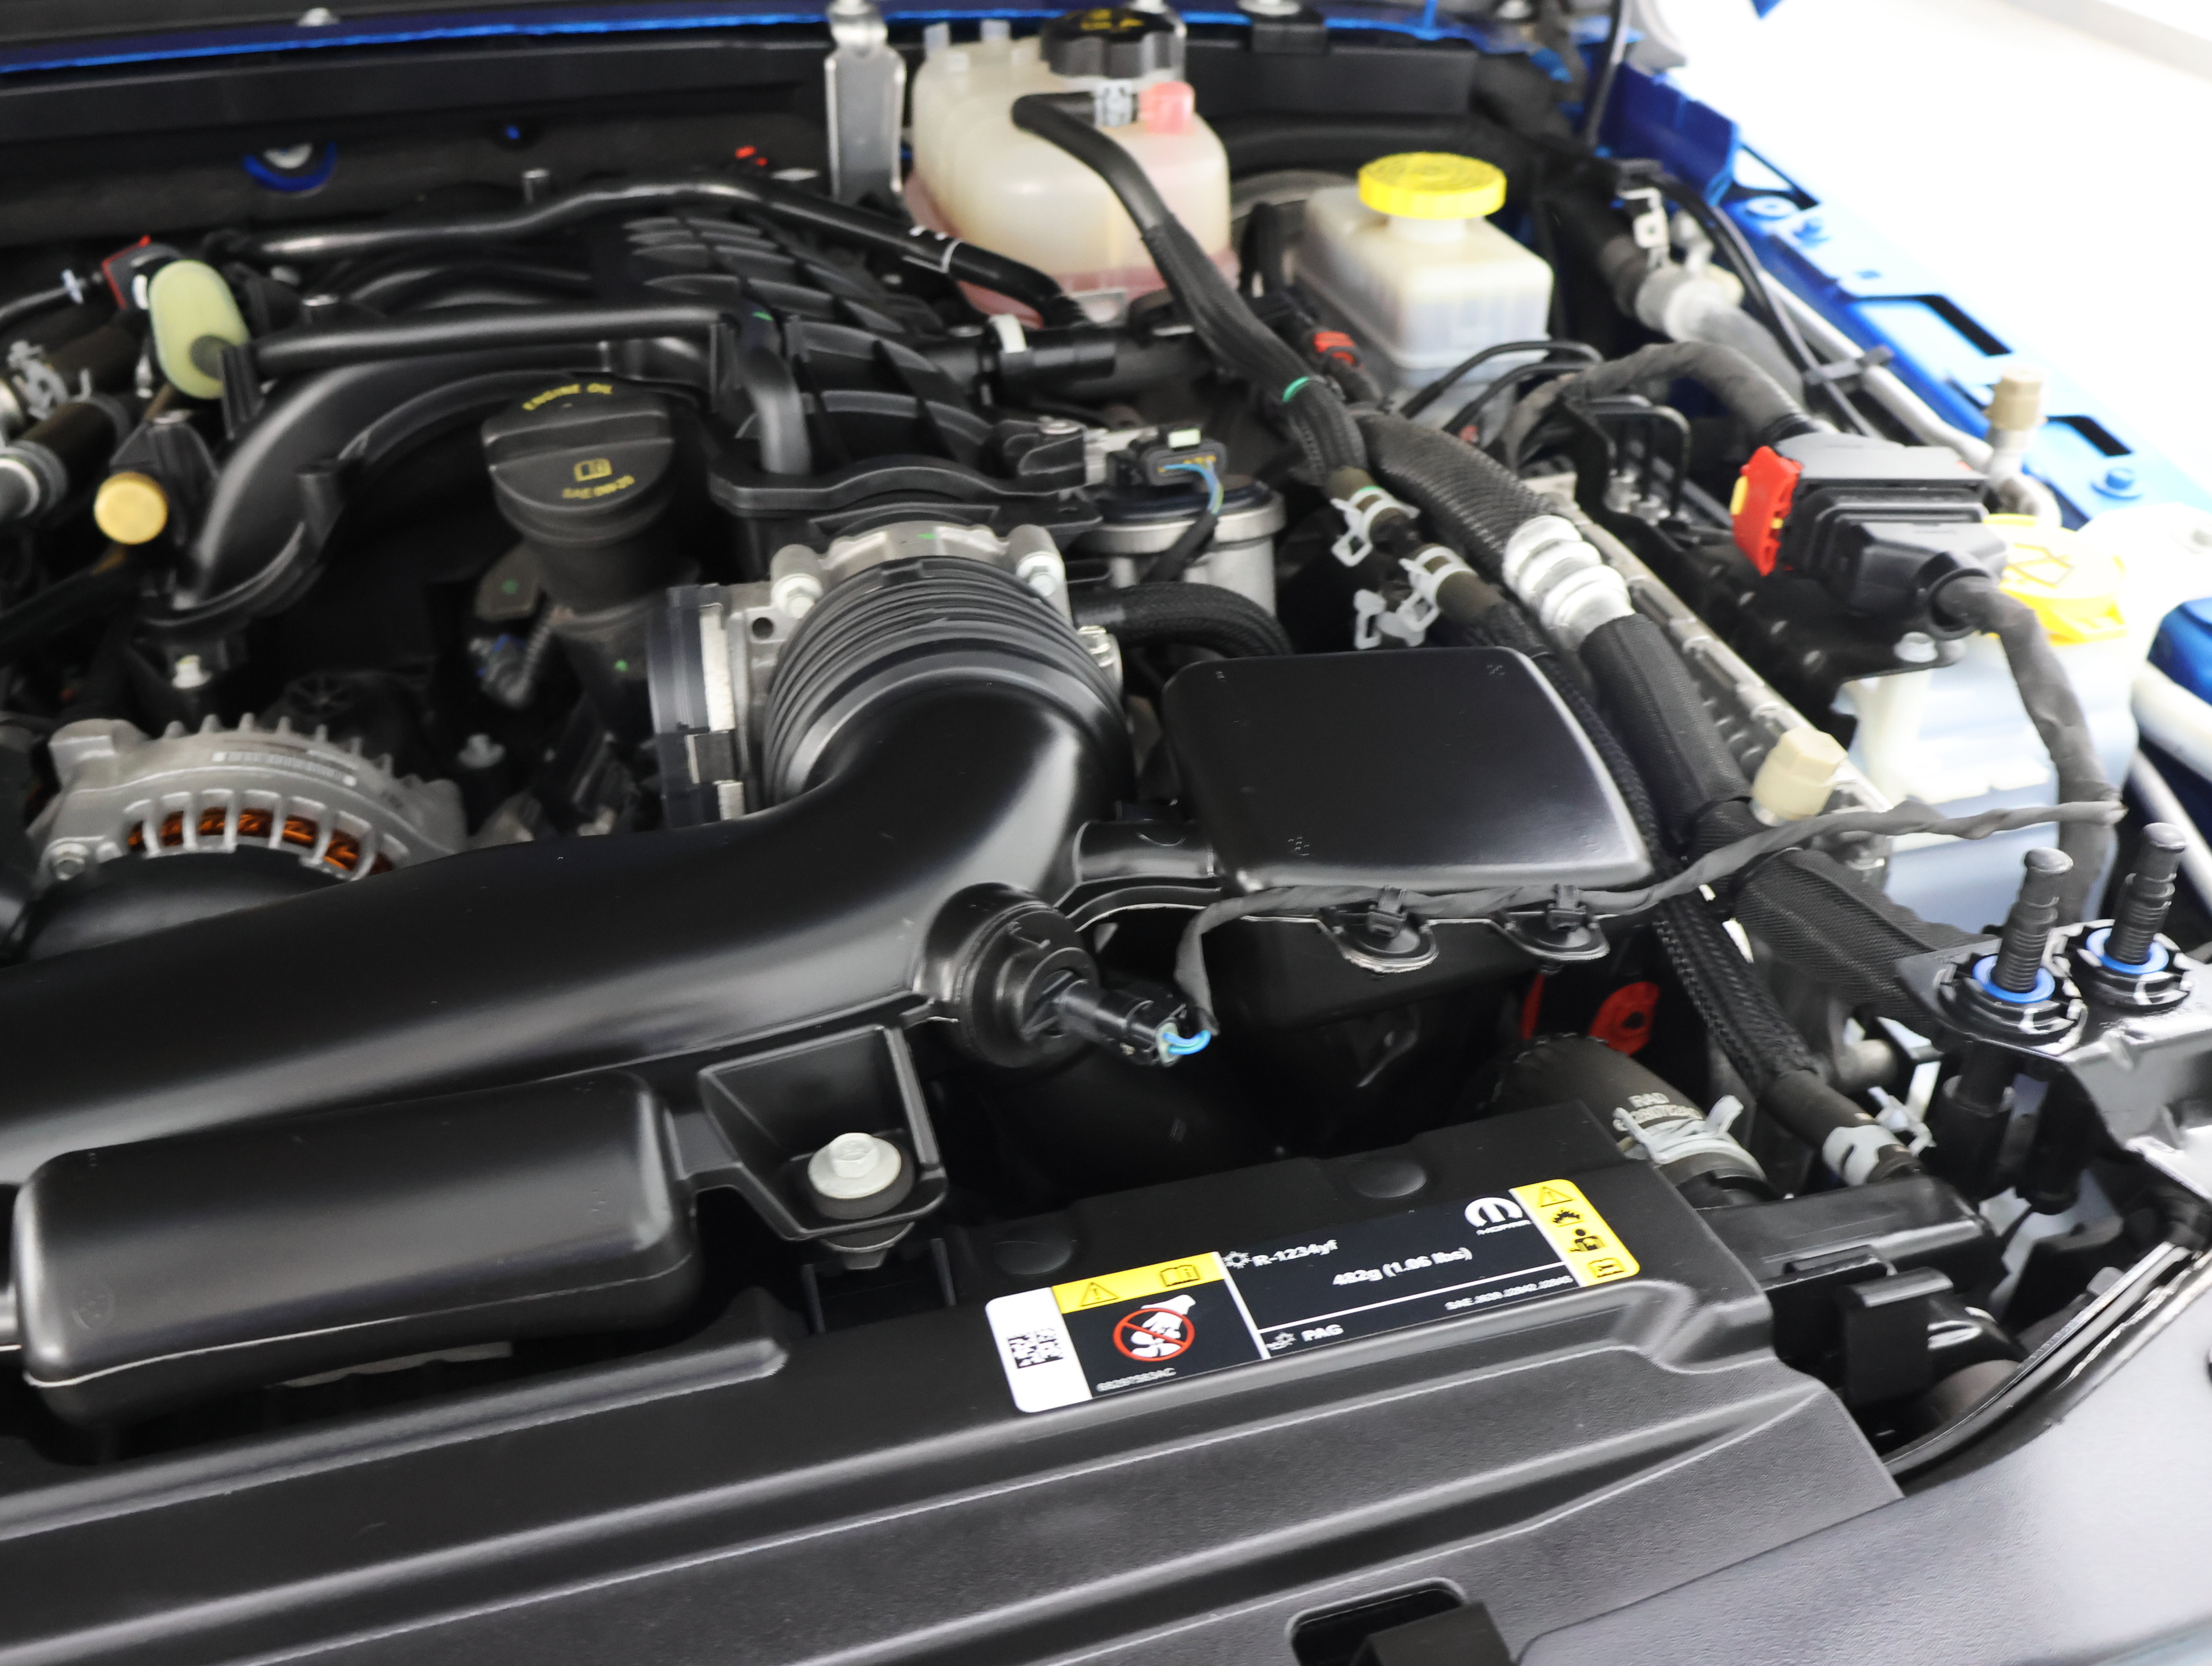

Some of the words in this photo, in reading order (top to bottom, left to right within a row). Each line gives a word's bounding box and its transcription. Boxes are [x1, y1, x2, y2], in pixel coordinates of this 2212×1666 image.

[1252, 1239, 1338, 1266] R-1234yf
[1333, 1269, 1383, 1285] 482g
[1382, 1256, 1432, 1277] (1.06
[1431, 1247, 1473, 1265] lbs)
[1444, 1298, 1474, 1310] SAE
[1301, 1324, 1344, 1342] PAG
